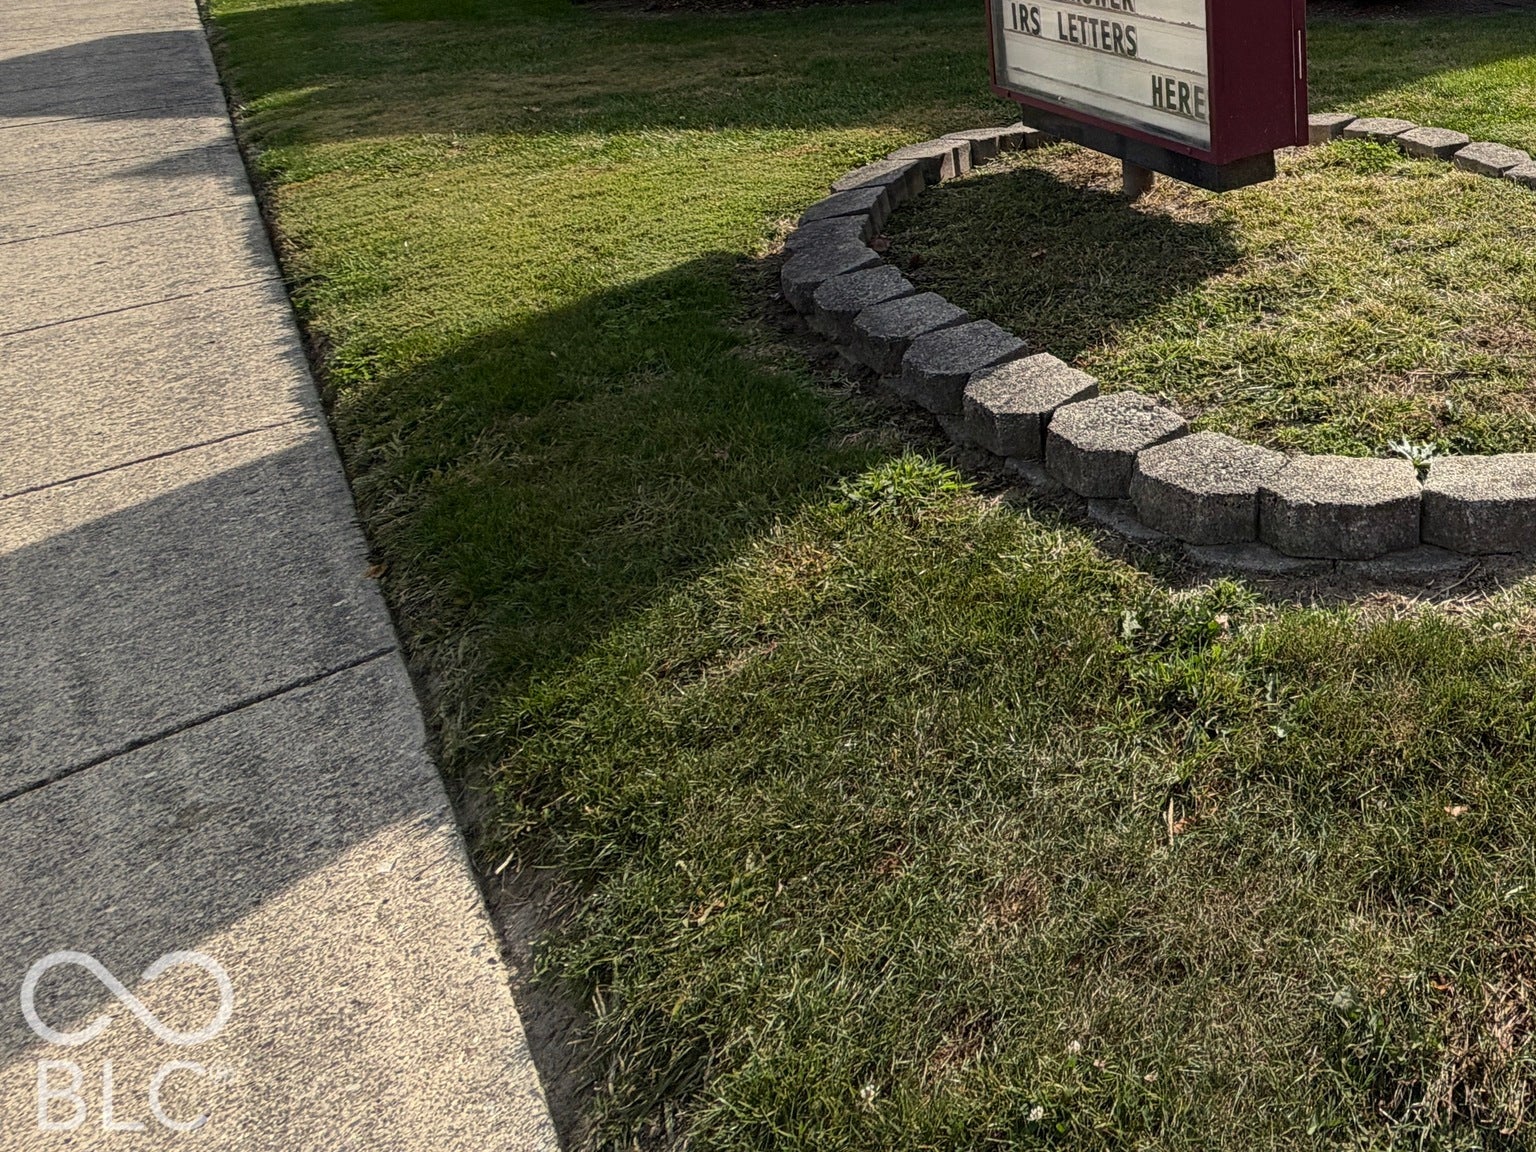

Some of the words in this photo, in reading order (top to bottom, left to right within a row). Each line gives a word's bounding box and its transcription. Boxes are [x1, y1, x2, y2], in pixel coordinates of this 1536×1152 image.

[1011, 2, 1041, 36] IRS
[1057, 11, 1138, 58] LETTERS
[1151, 74, 1206, 119] HERE
